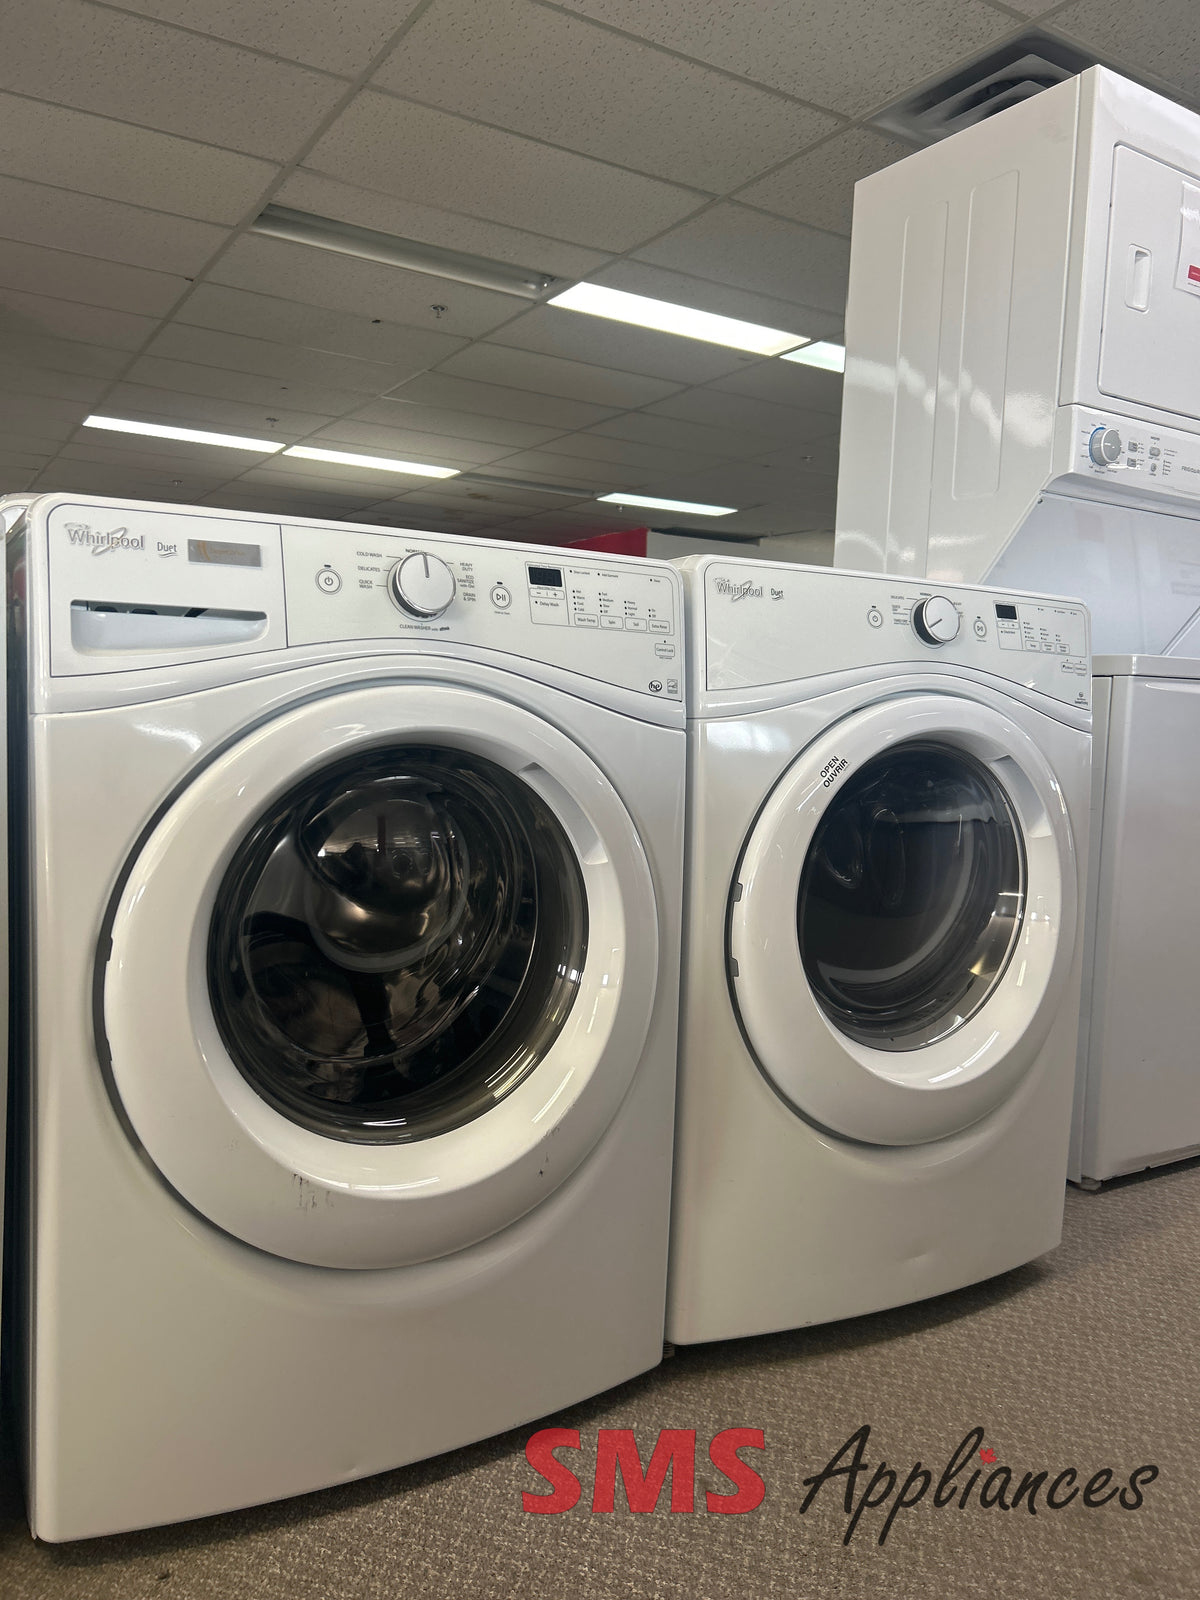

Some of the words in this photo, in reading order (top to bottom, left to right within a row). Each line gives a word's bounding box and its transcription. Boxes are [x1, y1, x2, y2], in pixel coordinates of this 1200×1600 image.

[65, 524, 145, 554] Whirlpool
[156, 541, 177, 553] Duet
[715, 579, 763, 599] Whirlpool
[770, 587, 784, 597] Duet
[819, 755, 839, 778] OPEN
[823, 758, 848, 788] OUVRIR
